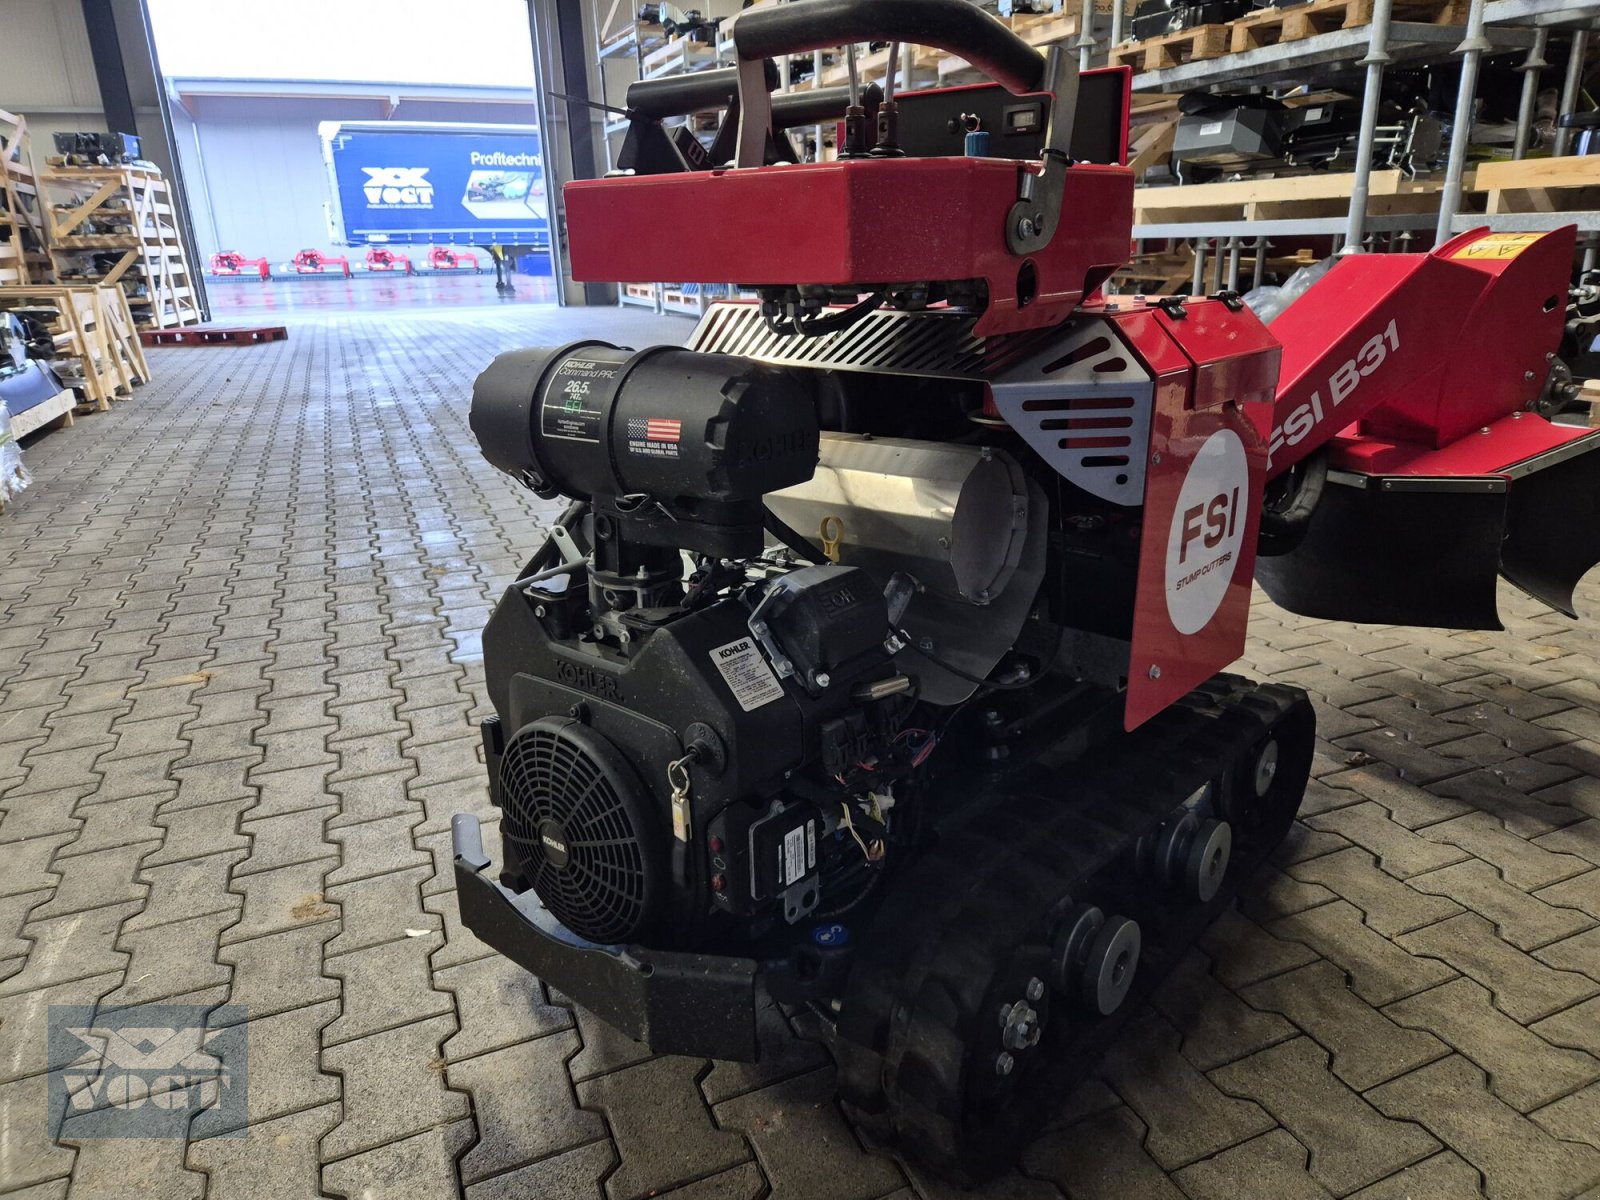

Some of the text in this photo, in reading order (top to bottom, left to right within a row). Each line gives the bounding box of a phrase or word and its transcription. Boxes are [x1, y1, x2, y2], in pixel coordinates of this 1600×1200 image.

[363, 187, 434, 204] VOGT
[559, 367, 599, 378] Command
[563, 361, 596, 370] KOHLER
[564, 380, 590, 394] 26.5
[1266, 318, 1400, 472] FSI B31
[564, 400, 582, 414] EFI
[646, 441, 660, 449] MADE
[1179, 486, 1239, 565] FSI
[1176, 551, 1232, 591] STUMP CUTTERS
[719, 641, 751, 660] KOHLER
[552, 658, 625, 702] KOHLER
[542, 835, 567, 854] KOHLER
